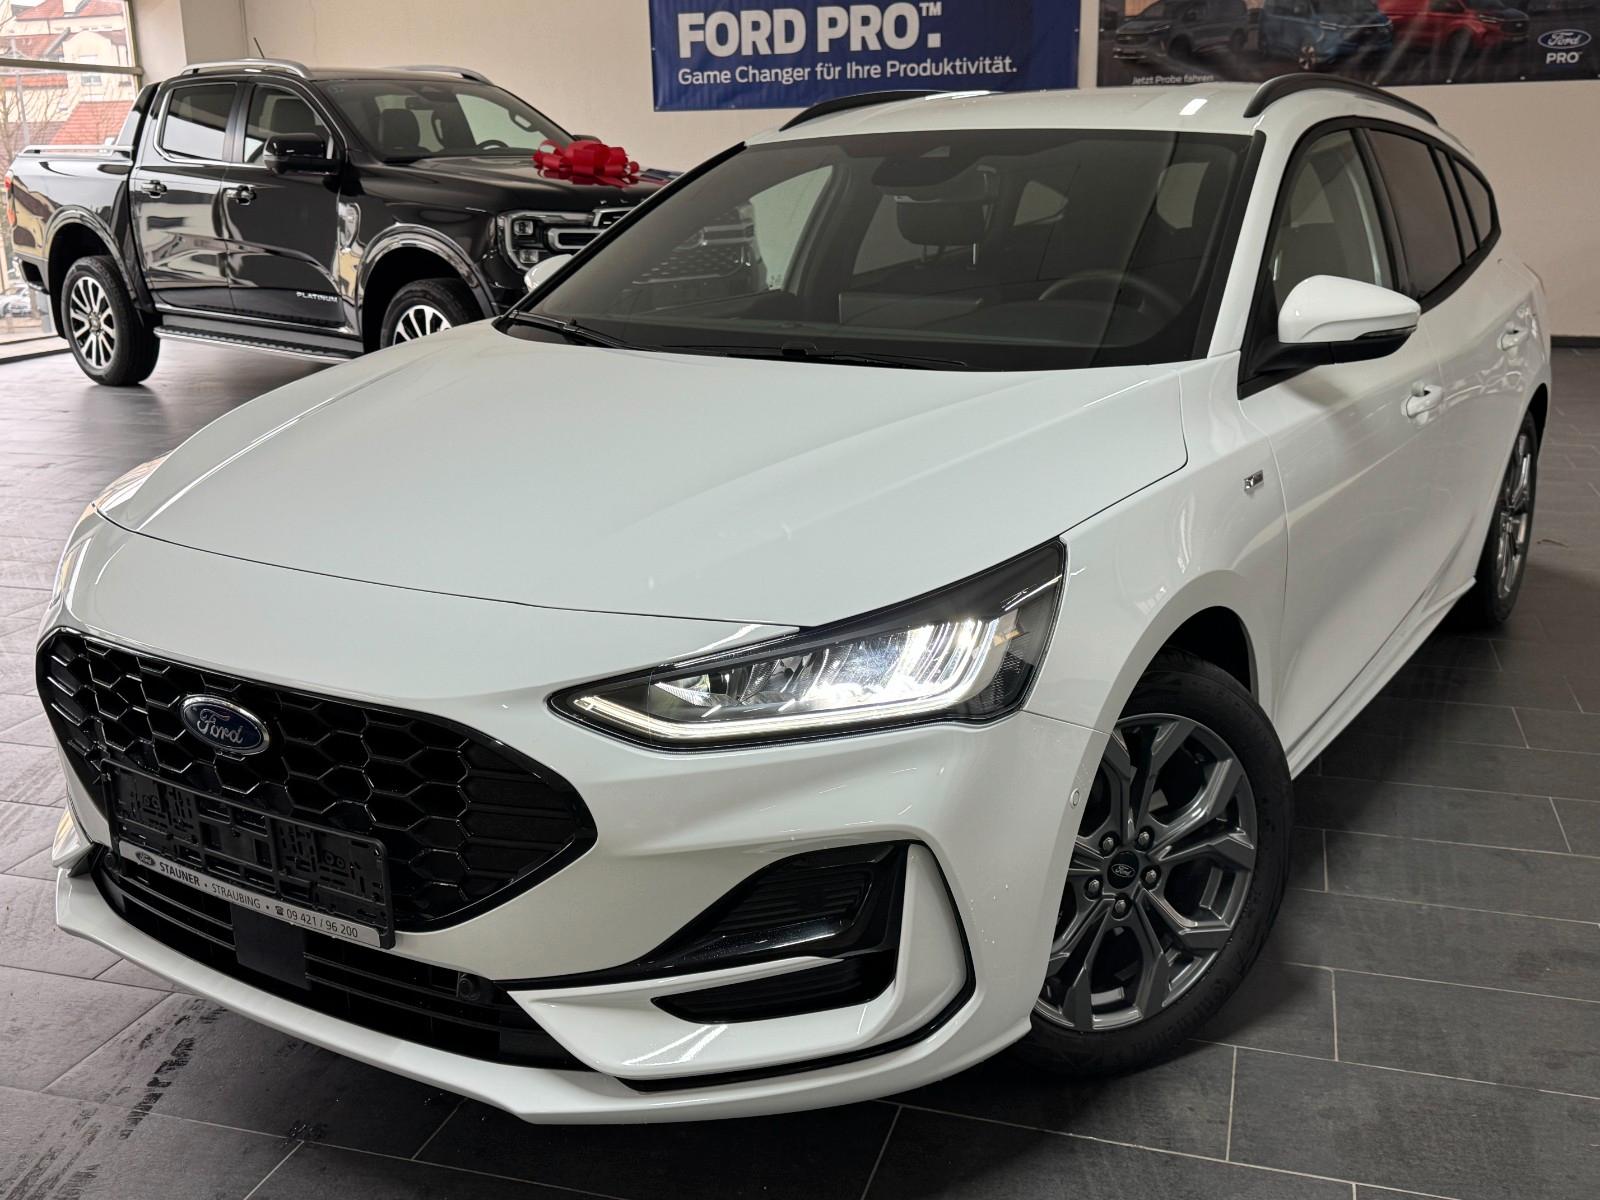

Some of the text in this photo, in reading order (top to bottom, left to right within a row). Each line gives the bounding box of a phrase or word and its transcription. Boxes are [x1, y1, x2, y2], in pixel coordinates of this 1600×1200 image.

[677, 8, 807, 59] FORD
[1547, 32, 1582, 46] Ford
[1546, 52, 1579, 64] PRO
[678, 56, 1017, 85] Game Changer für Ihre Produktivität.
[1132, 75, 1154, 85] Jetzt
[1155, 74, 1182, 84] Probe
[296, 291, 338, 302] PLATINUM
[197, 709, 243, 743] Ford
[160, 862, 201, 887] STAUNER
[211, 883, 261, 909] STRAUBING
[286, 909, 298, 921] 09
[300, 913, 317, 927] 421
[326, 919, 338, 932] 96
[341, 924, 358, 938] 200
